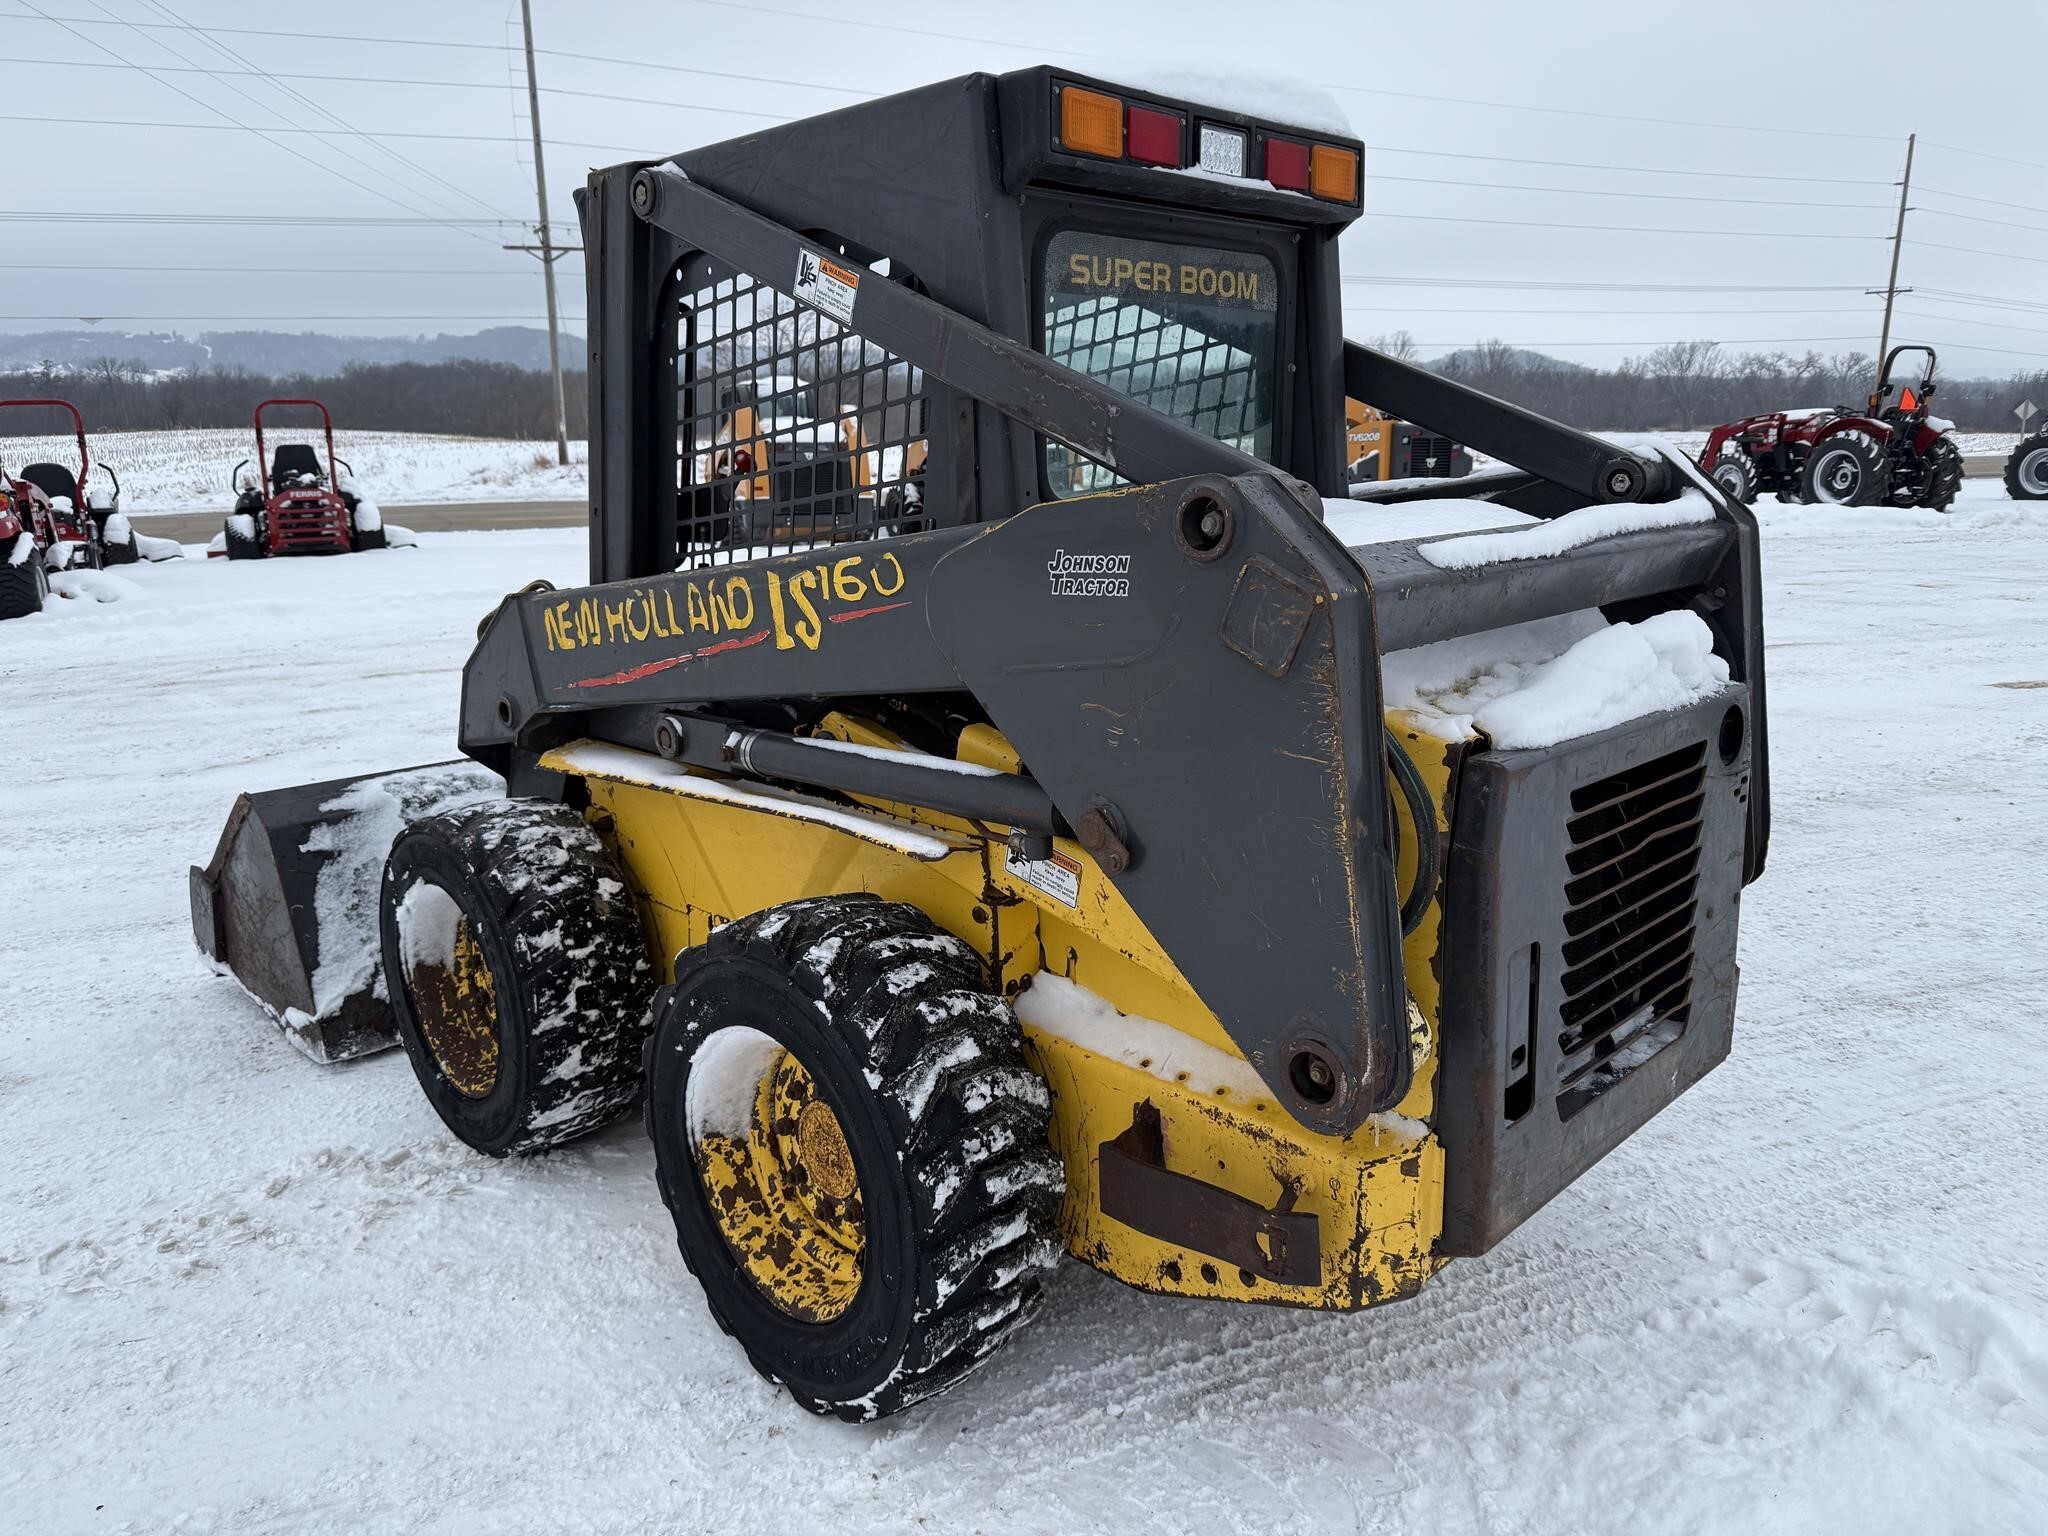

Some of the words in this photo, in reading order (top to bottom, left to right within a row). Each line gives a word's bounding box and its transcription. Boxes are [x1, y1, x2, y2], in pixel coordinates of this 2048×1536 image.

[829, 267, 855, 285] WARNING
[1069, 253, 1171, 292] SUPER
[1180, 265, 1258, 301] BOOM
[290, 490, 322, 498] FERRIS
[1047, 549, 1131, 573] JOHNSON
[1050, 571, 1130, 597] TRACTOR
[544, 597, 601, 651] NEW
[605, 575, 754, 644] HOLLAND
[1057, 868, 1070, 879] AREA
